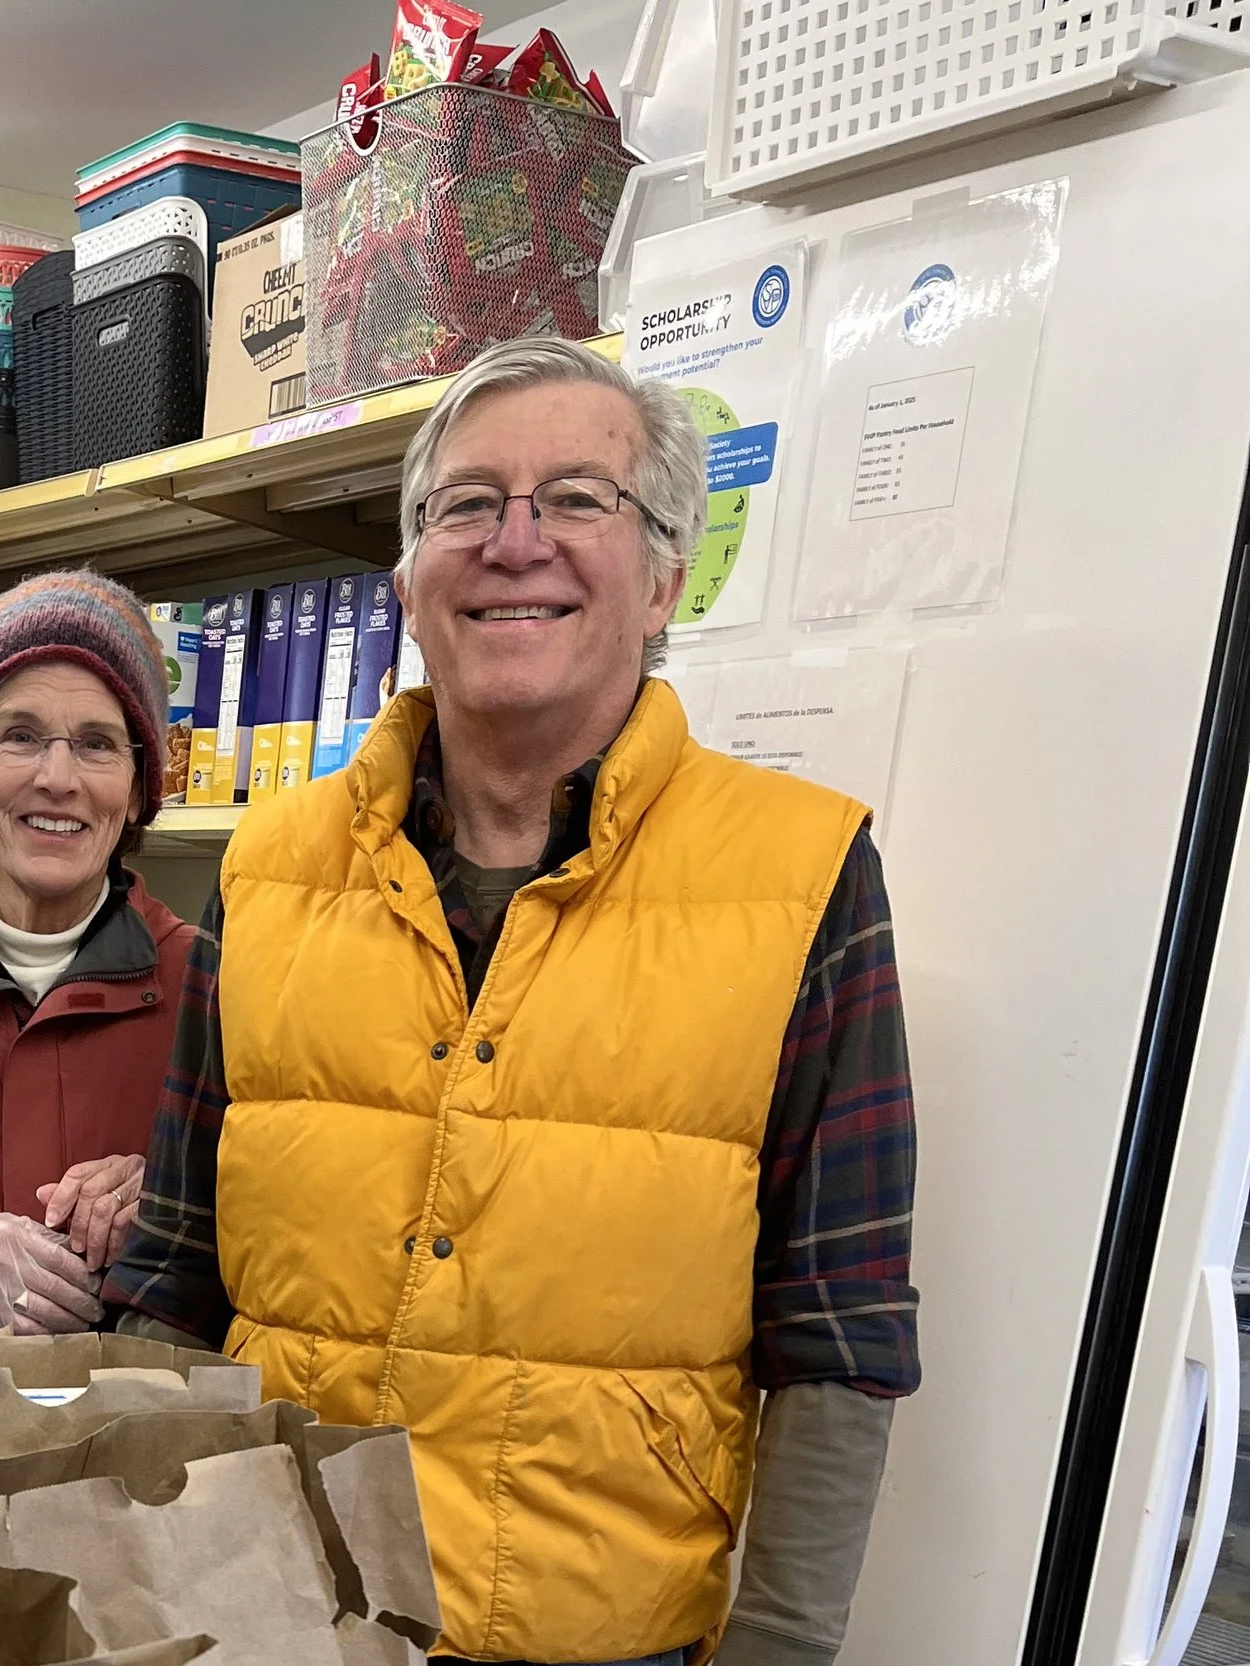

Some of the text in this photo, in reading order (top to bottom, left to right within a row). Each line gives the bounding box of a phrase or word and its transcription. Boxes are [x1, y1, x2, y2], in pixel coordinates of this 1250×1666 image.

[640, 314, 731, 351] OPPORTUNTY
[638, 337, 764, 374] Would you like to strengthen your
[682, 358, 720, 378] potential?
[880, 400, 899, 409] January
[905, 396, 917, 405] 2025
[876, 430, 892, 440] Pantry
[893, 428, 904, 436] Food
[905, 425, 919, 434] Limits
[920, 423, 928, 431] Per
[928, 418, 955, 430] Household
[709, 439, 731, 450] Society
[717, 446, 754, 460] scholarships
[754, 444, 762, 453] to
[714, 455, 771, 472] achieve your goals.
[715, 474, 735, 484] $2000.
[706, 521, 739, 534] olarships
